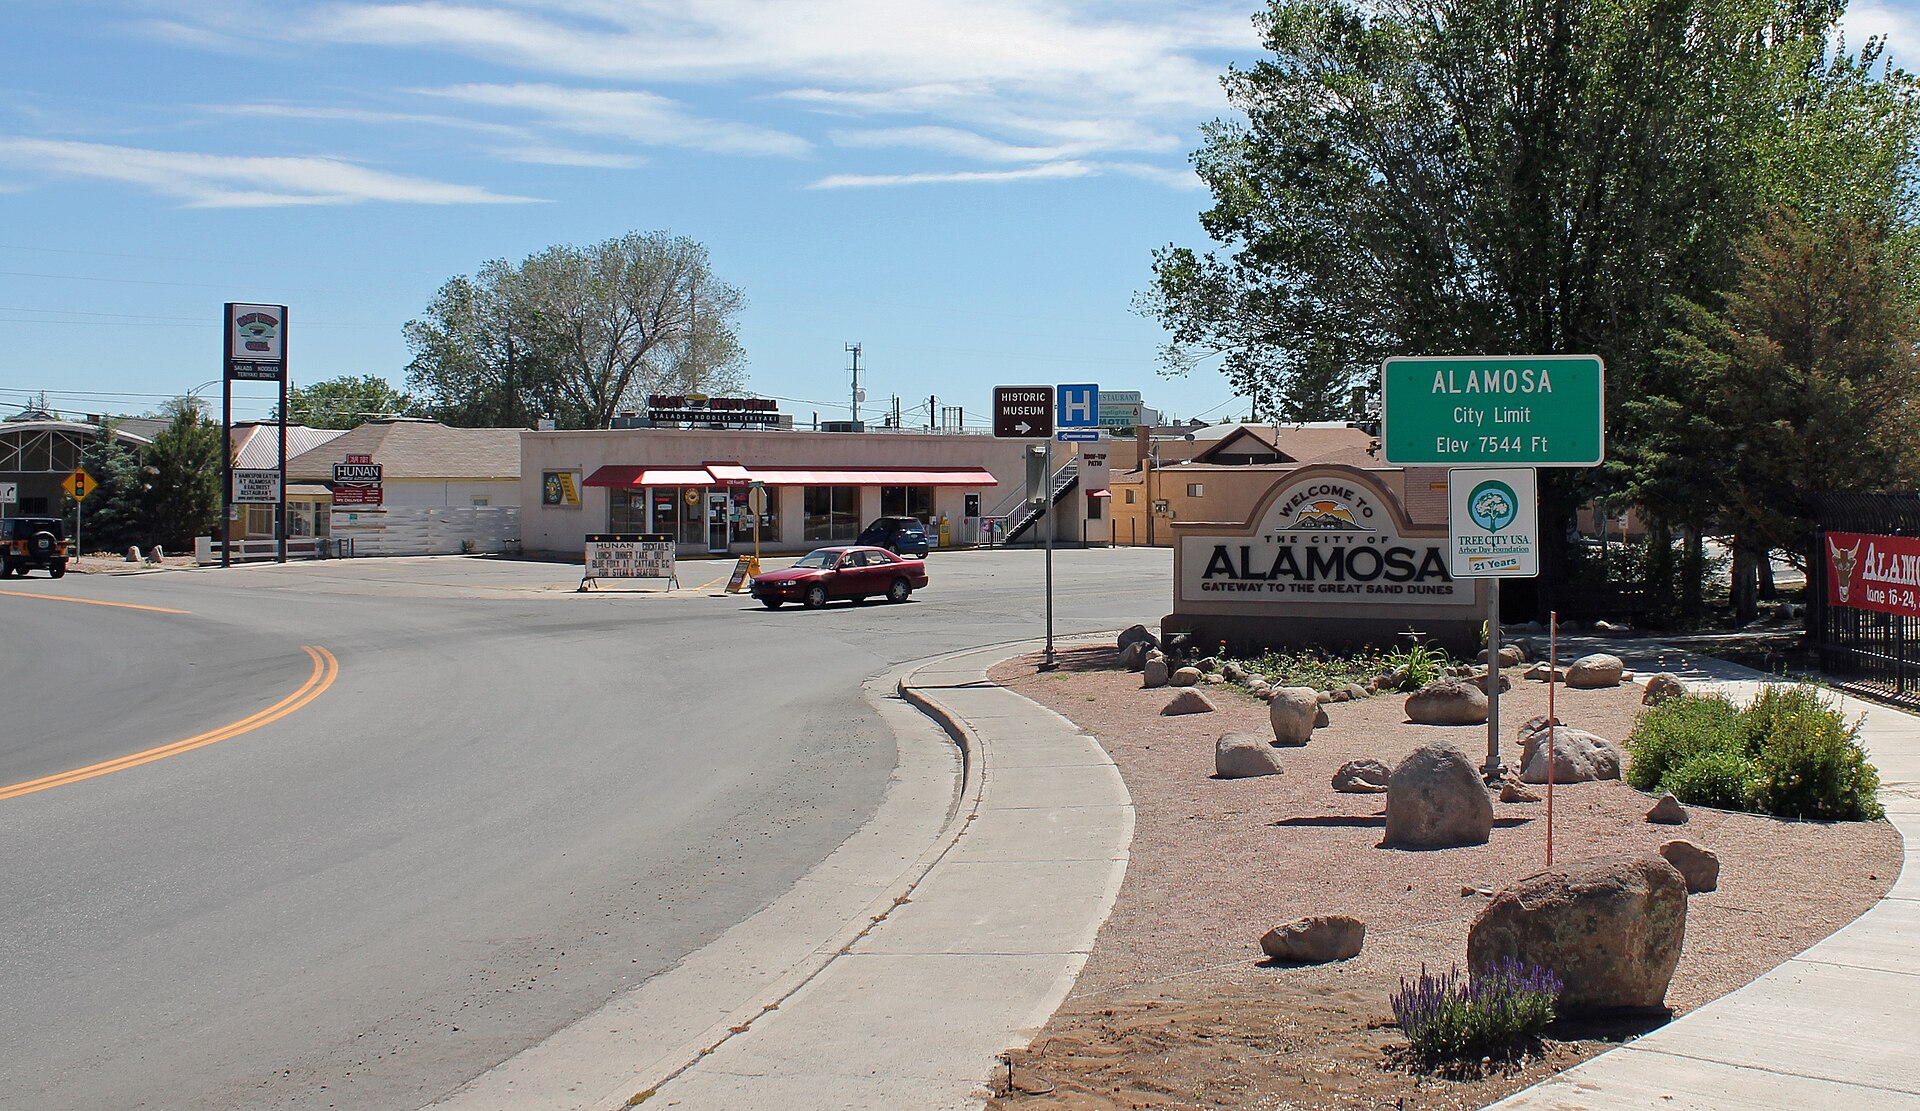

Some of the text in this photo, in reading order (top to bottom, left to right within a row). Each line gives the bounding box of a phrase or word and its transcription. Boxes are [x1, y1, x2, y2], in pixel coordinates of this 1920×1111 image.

[1432, 370, 1552, 394] ALAMOSA
[649, 395, 778, 412] EAST WEST GRILL
[1002, 392, 1046, 402] HISTORIC
[1003, 406, 1044, 415] MUSEUM
[1066, 390, 1090, 421] H
[1454, 406, 1530, 426] City Limit
[1437, 436, 1548, 452] Elev 7544 Ft
[338, 466, 378, 476] HUNAN
[1280, 484, 1373, 518] WELCOME TO
[642, 543, 669, 551] COCKTAILS
[1458, 535, 1529, 545] TREE CITY USA
[1202, 545, 1454, 582] ALAMOSA
[1488, 558, 1517, 568] Years
[1202, 582, 1454, 595] GATEWAY TO THE GREAT SAND DUNES
